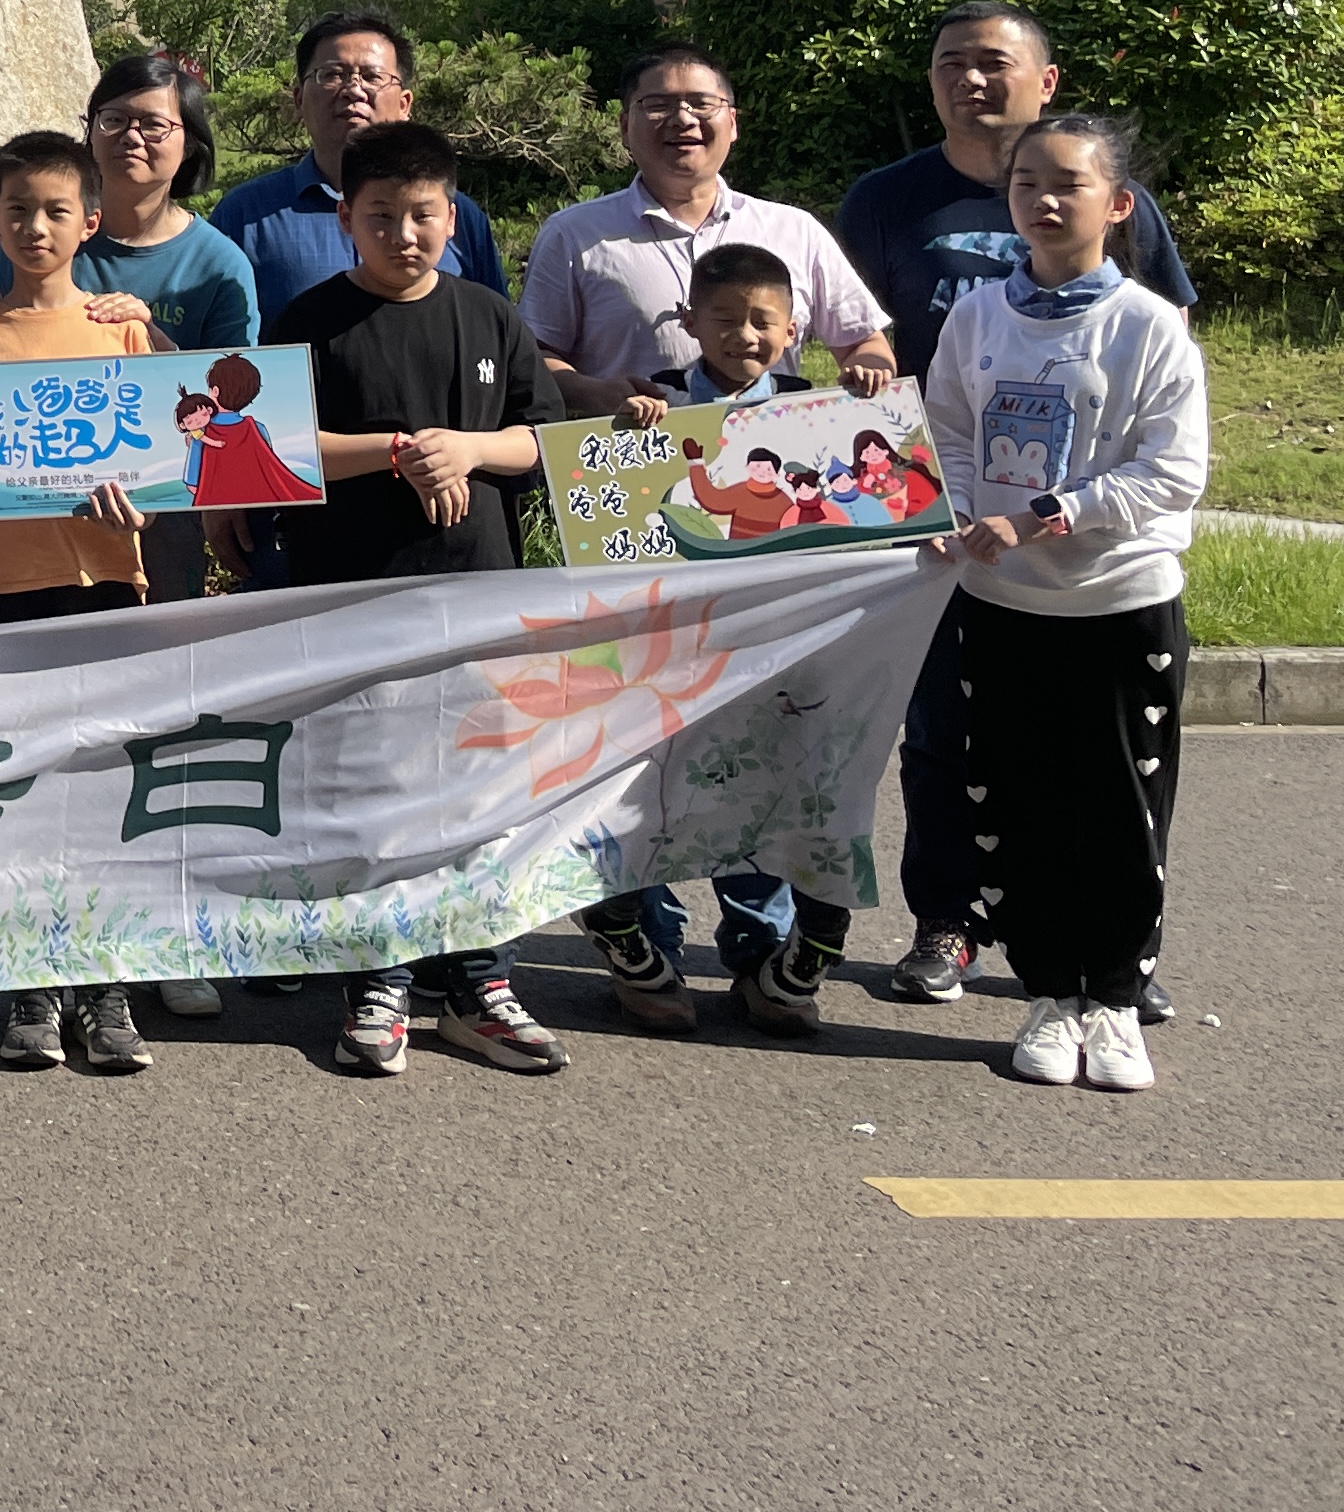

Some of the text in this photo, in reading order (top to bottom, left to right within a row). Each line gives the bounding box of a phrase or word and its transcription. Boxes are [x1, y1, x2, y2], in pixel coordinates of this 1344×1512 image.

[148, 301, 186, 327] ALS
[477, 358, 495, 384] NY
[997, 396, 1051, 417] Milk
[580, 430, 677, 473] 我爱你
[569, 486, 627, 520] 爸爸
[604, 525, 676, 561] 妈妈
